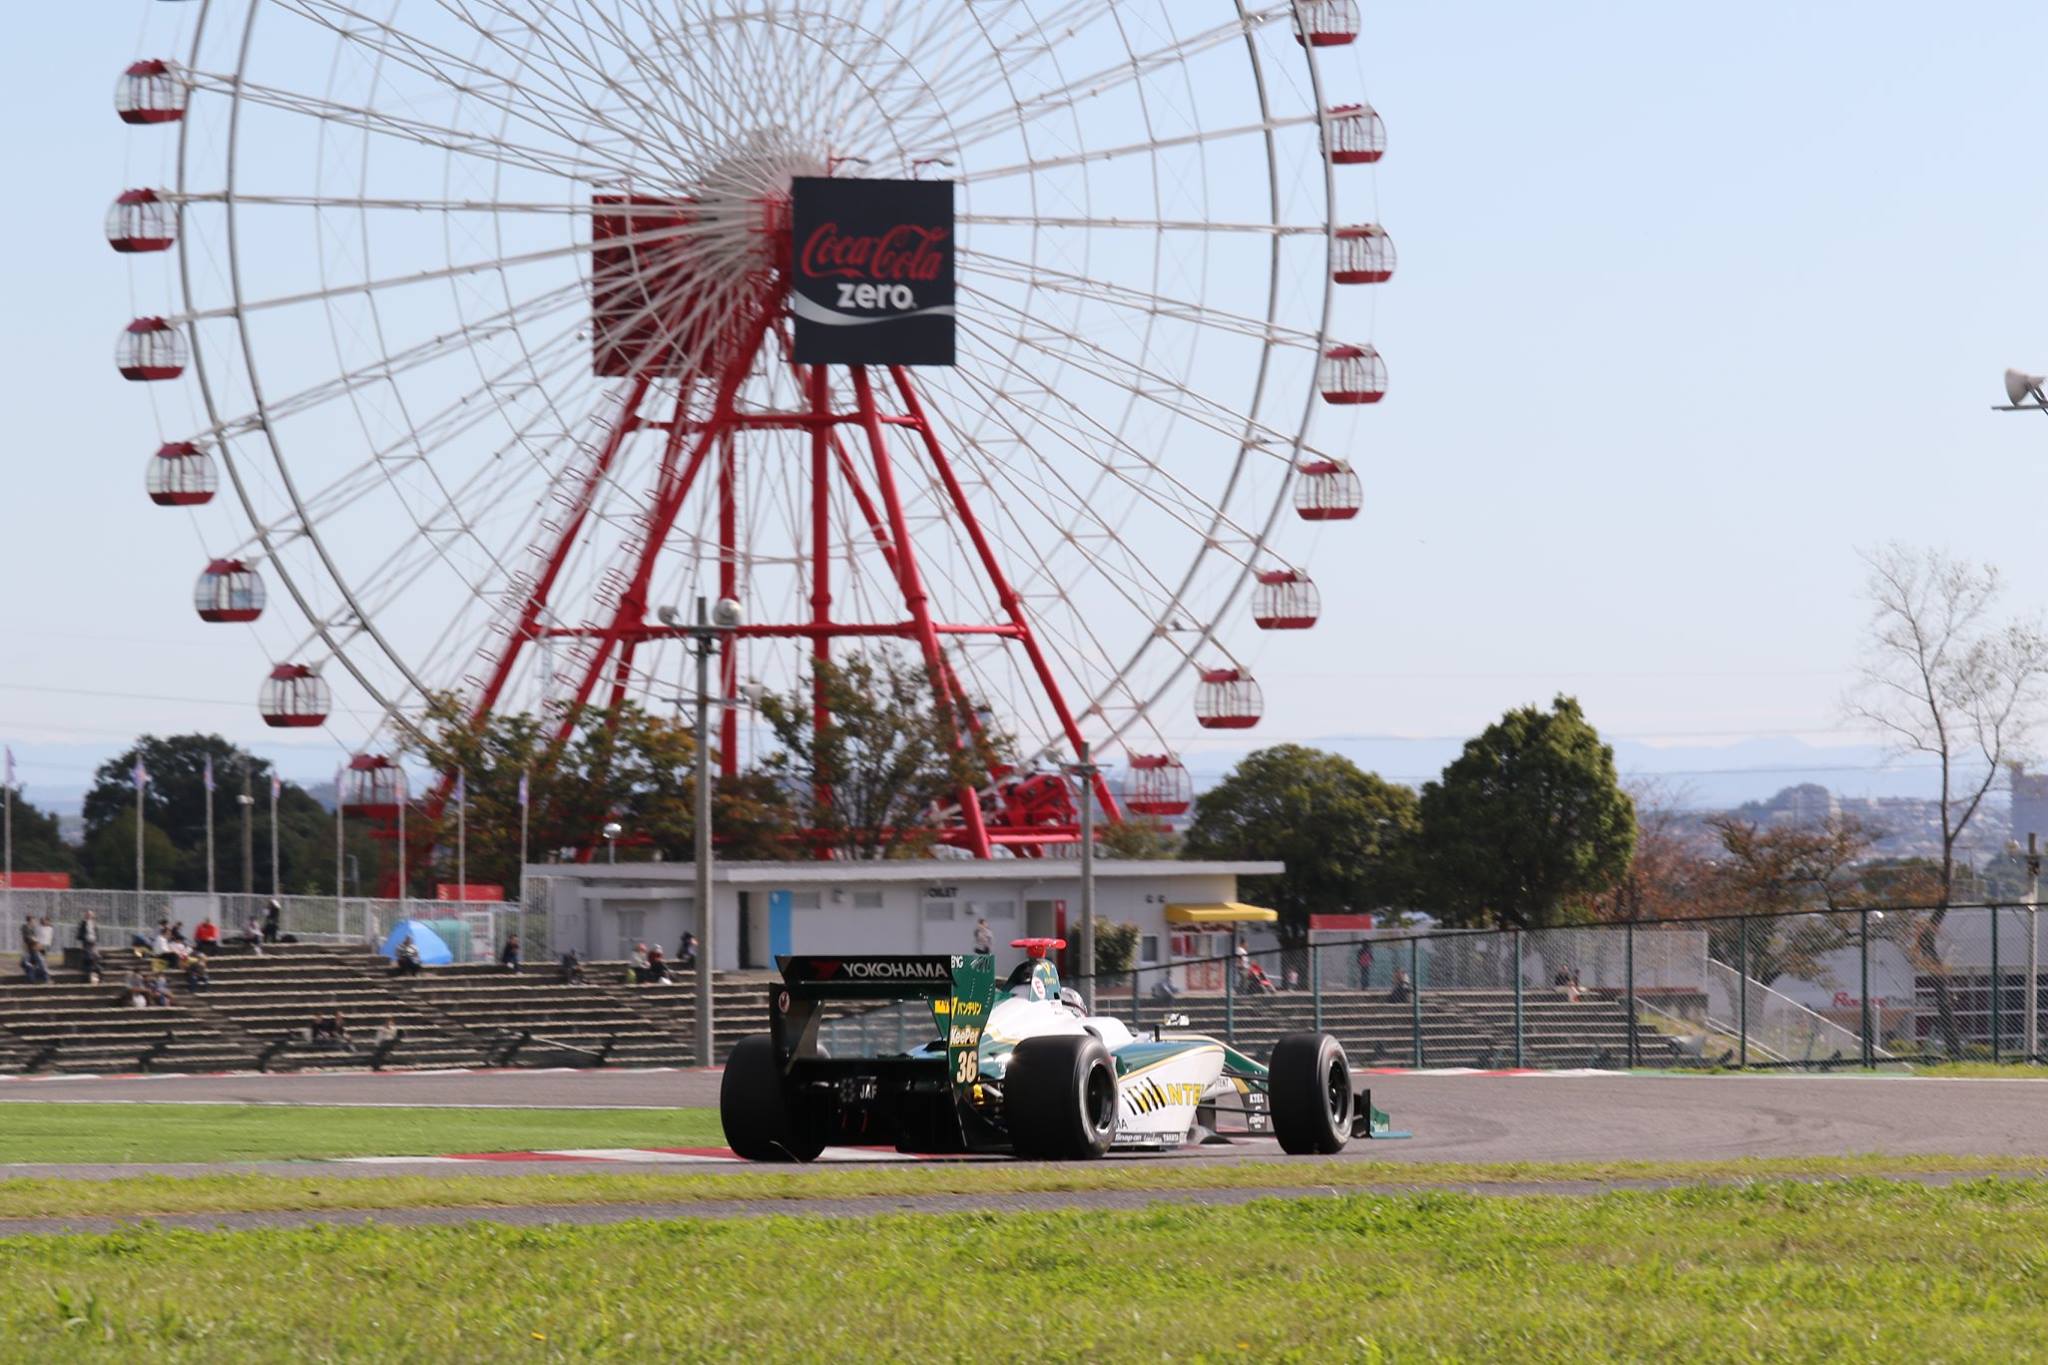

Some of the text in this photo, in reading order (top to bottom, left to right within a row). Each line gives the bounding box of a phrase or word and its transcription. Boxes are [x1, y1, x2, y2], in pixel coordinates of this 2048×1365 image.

[836, 283, 914, 310] zero
[842, 963, 948, 977] YOKOHAMA
[957, 1050, 977, 1083] 36
[860, 1083, 877, 1099] JAF
